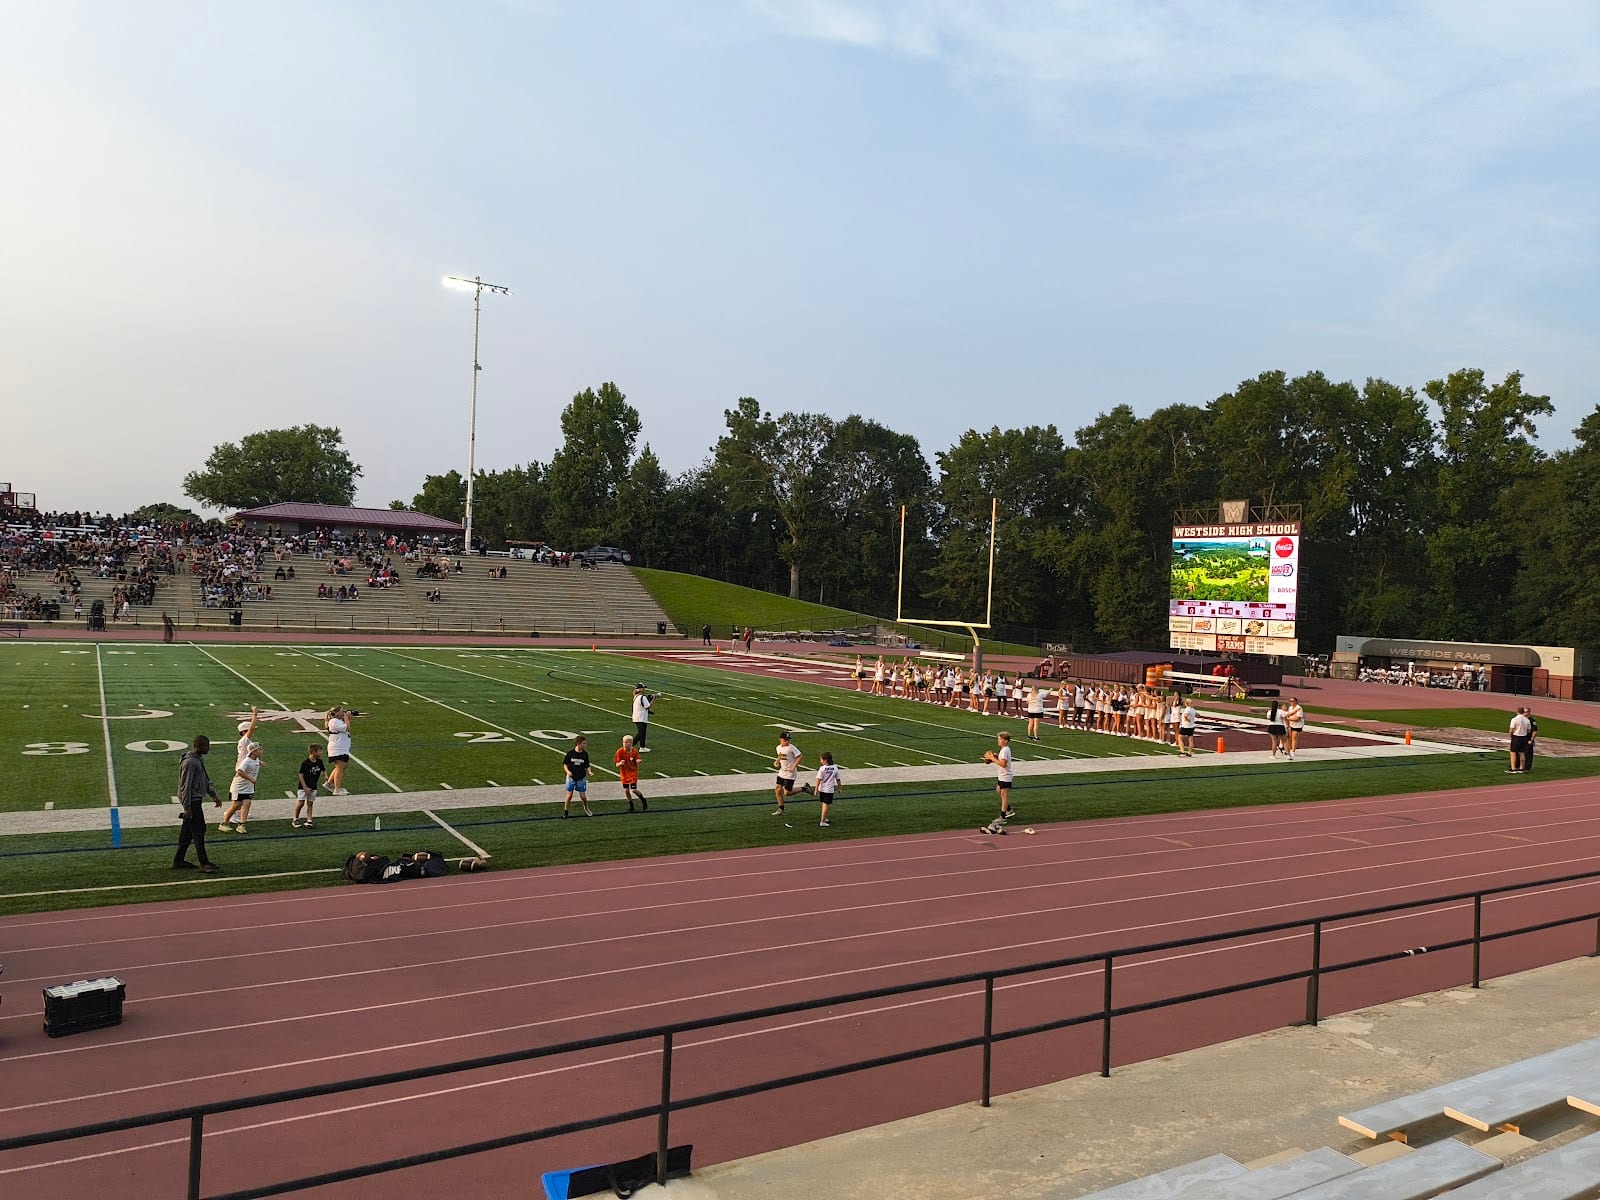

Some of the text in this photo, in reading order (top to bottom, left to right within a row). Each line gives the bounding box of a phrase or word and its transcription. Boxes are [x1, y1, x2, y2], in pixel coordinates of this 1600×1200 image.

[1175, 524, 1298, 537] WESTSIDE HIGH SCHOOL
[1226, 641, 1244, 649] RAMS
[1389, 648, 1491, 660] WESTSIDE RAMS
[454, 729, 581, 743] 20
[21, 740, 189, 756] 30
